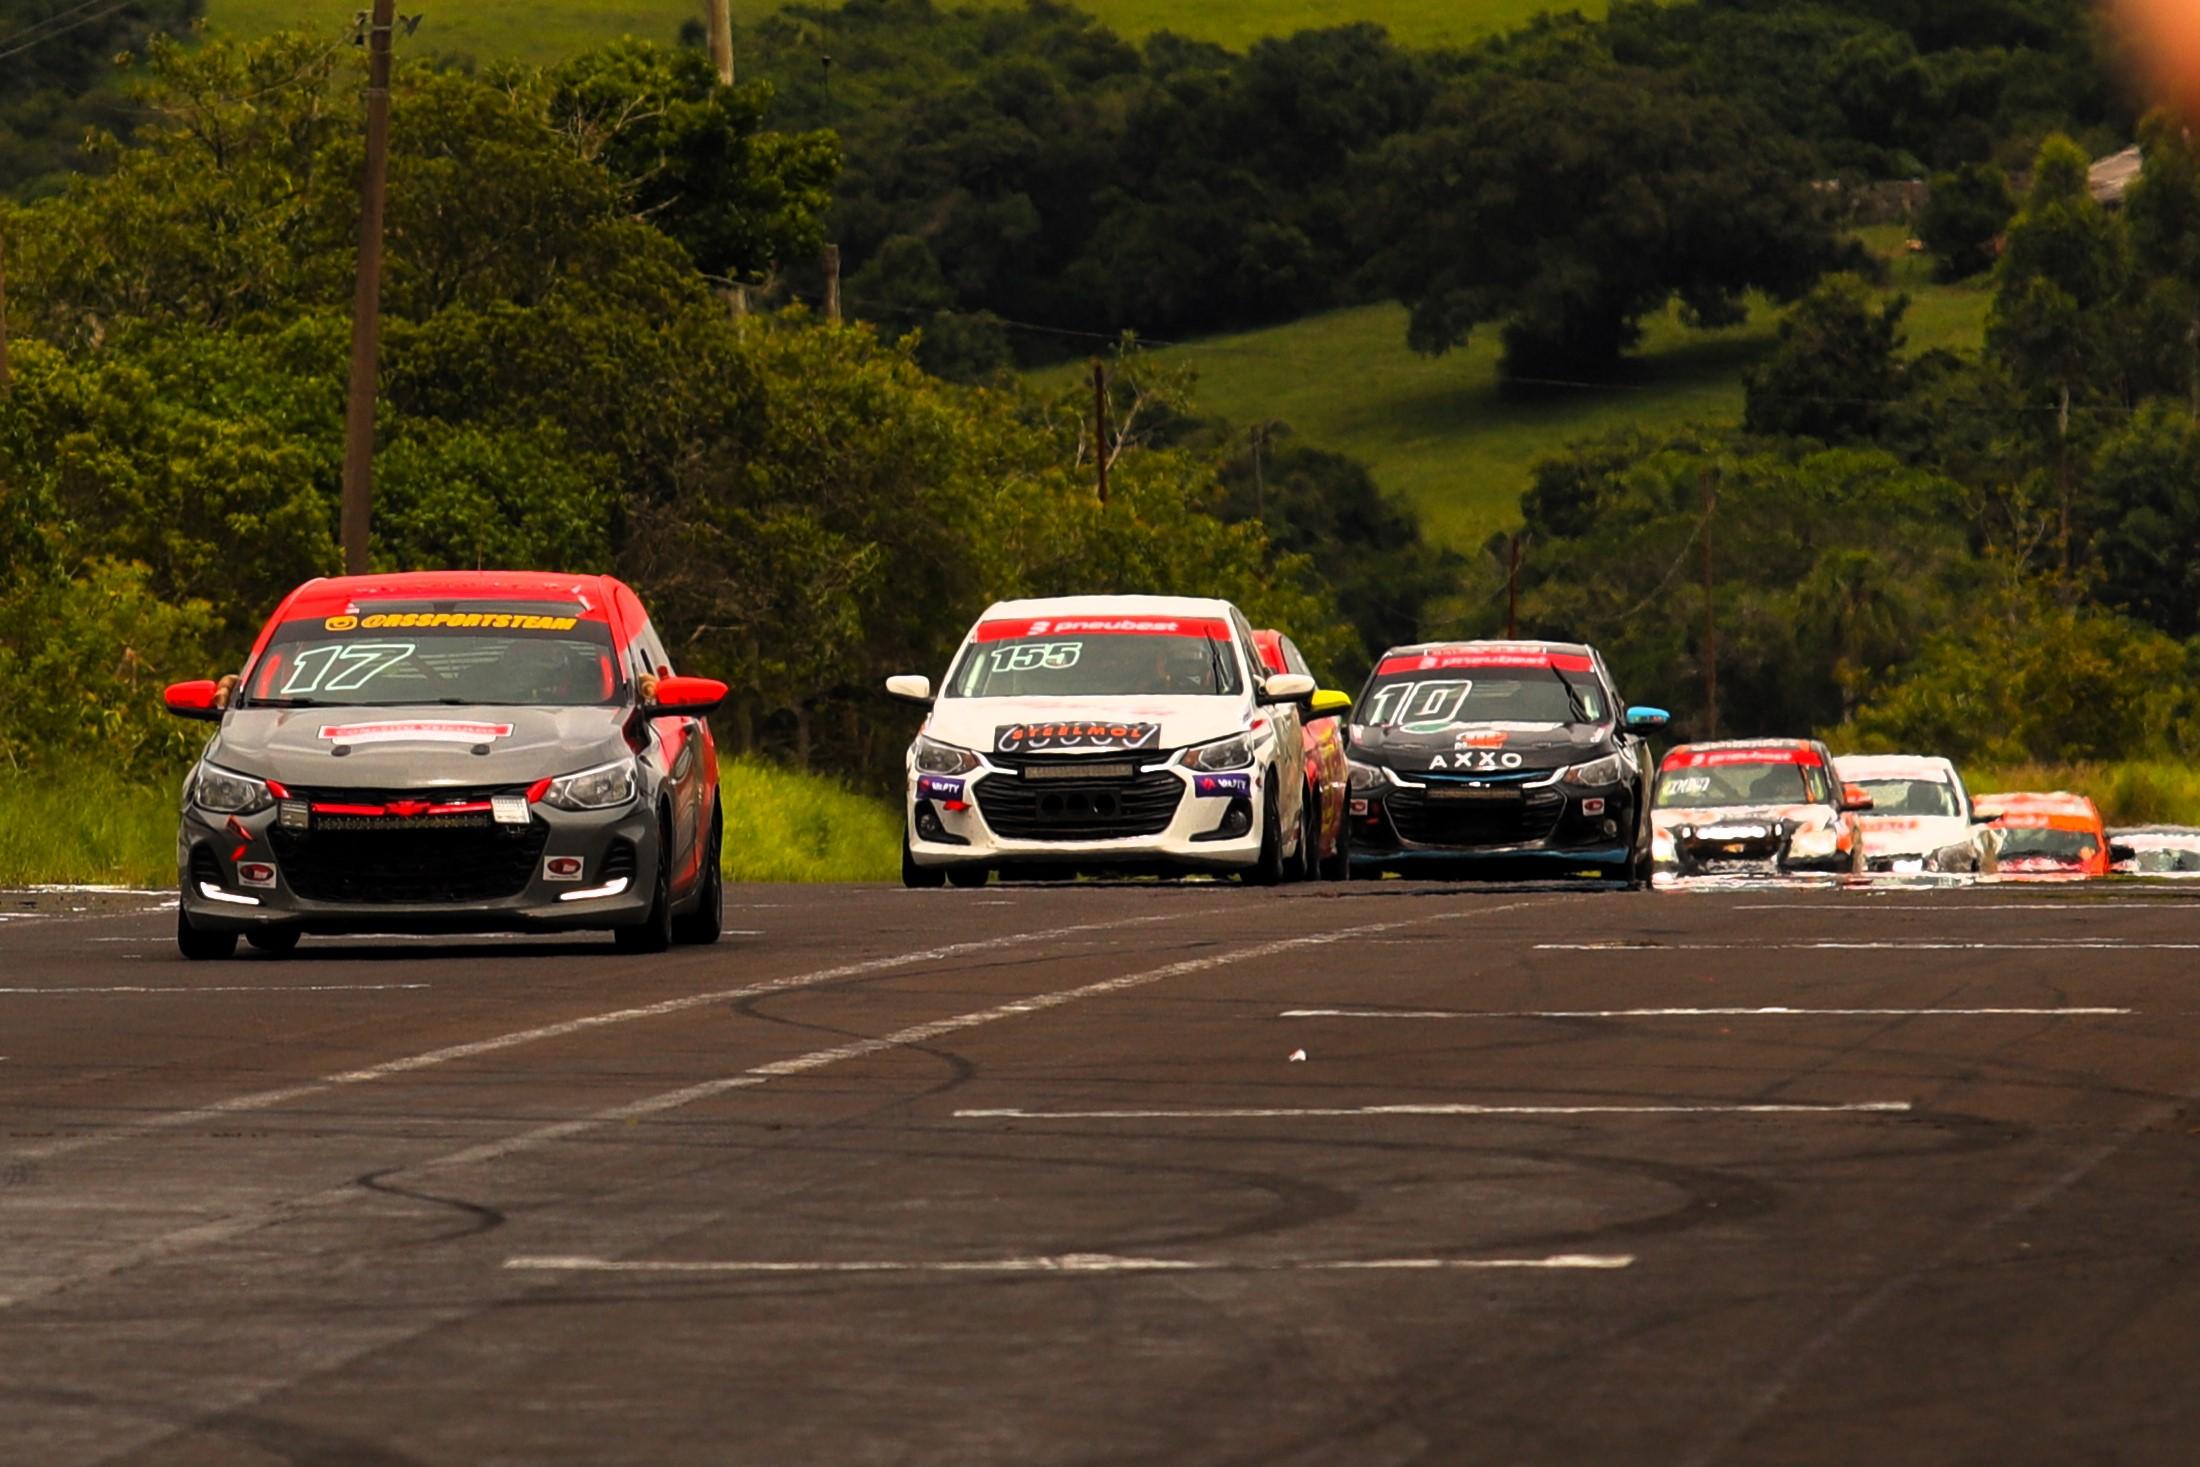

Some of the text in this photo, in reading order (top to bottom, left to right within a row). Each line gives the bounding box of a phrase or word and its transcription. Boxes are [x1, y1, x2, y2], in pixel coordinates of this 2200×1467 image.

[1054, 620, 1179, 632] pneubest
[281, 643, 416, 694] 17
[991, 641, 1083, 673] 155
[1369, 679, 1473, 727] 10
[1012, 726, 1142, 740] STEELMOL
[1428, 751, 1522, 770] AXXO
